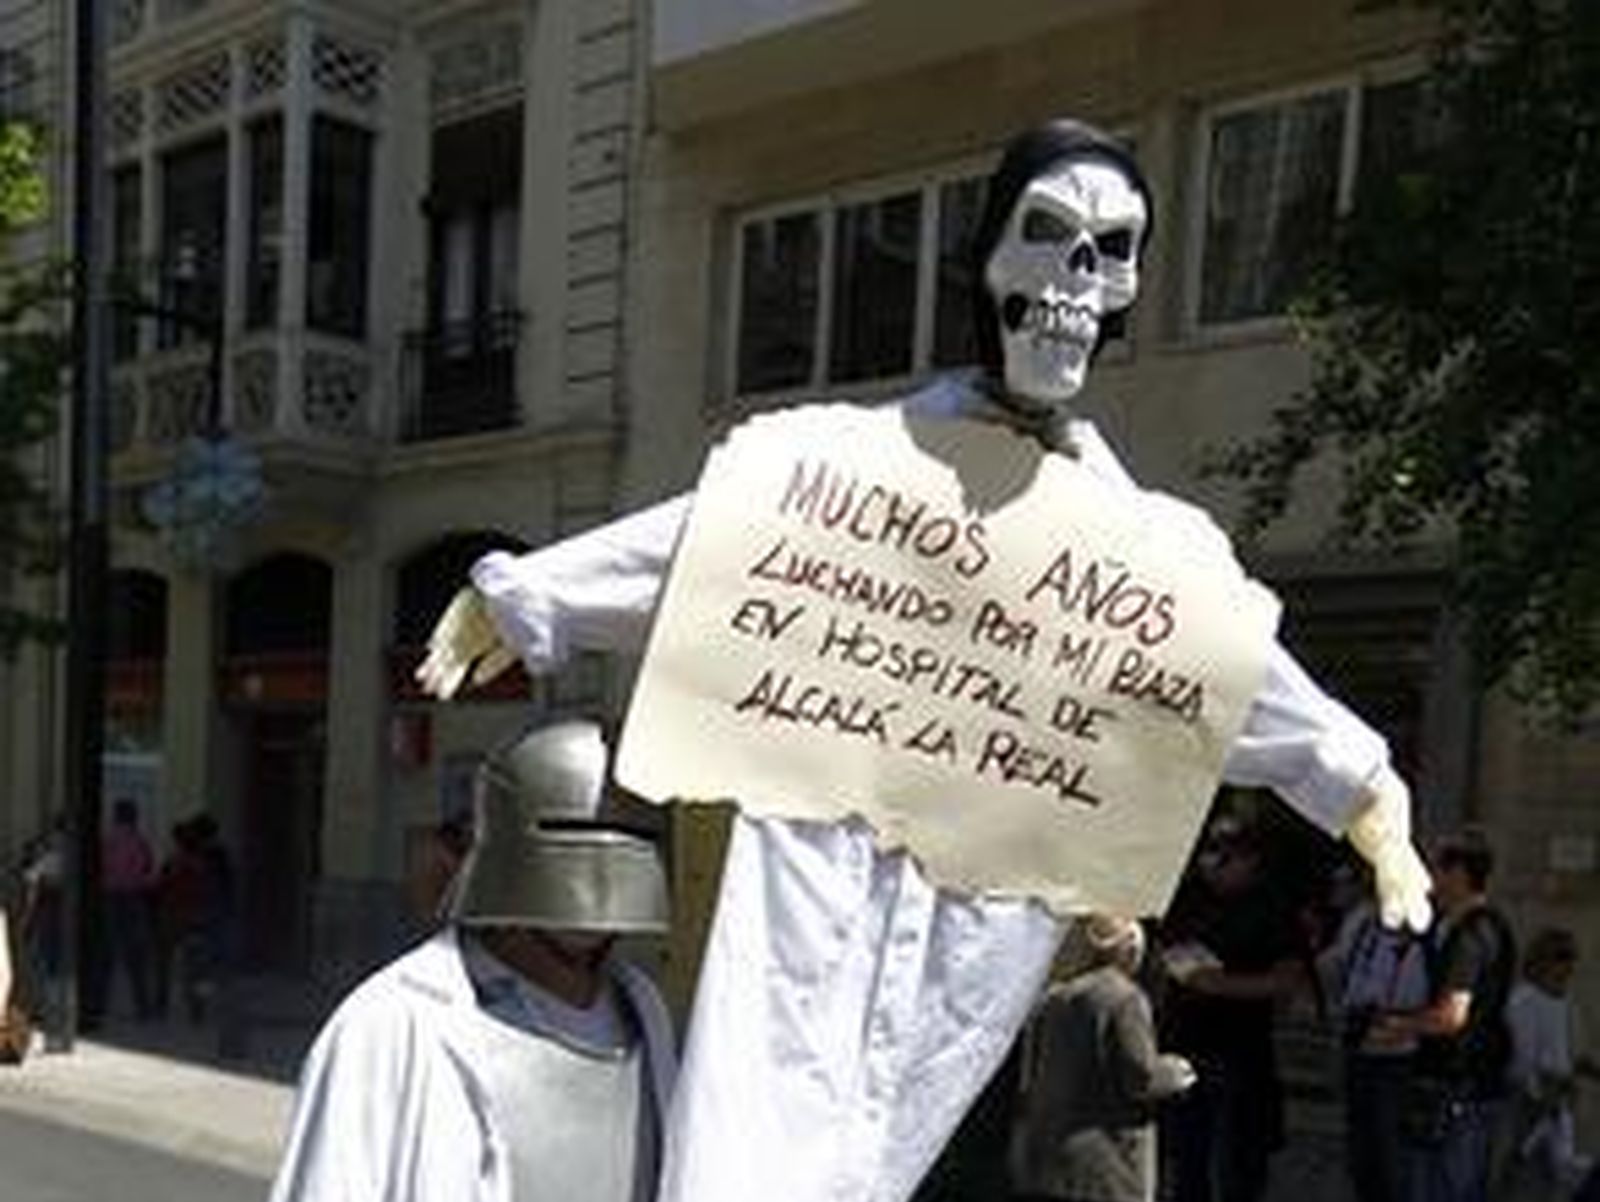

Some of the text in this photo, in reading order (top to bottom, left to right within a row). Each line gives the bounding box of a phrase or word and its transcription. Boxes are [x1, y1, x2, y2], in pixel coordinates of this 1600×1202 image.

[750, 540, 954, 627] LUCHANDO
[973, 599, 1039, 656] POR
[1054, 635, 1106, 687] MI
[780, 461, 1175, 646] MUCHOS AÑOS
[731, 600, 1118, 742] EN HOSPITAL DE
[736, 671, 1100, 807] ALCALÁ LA REAL
